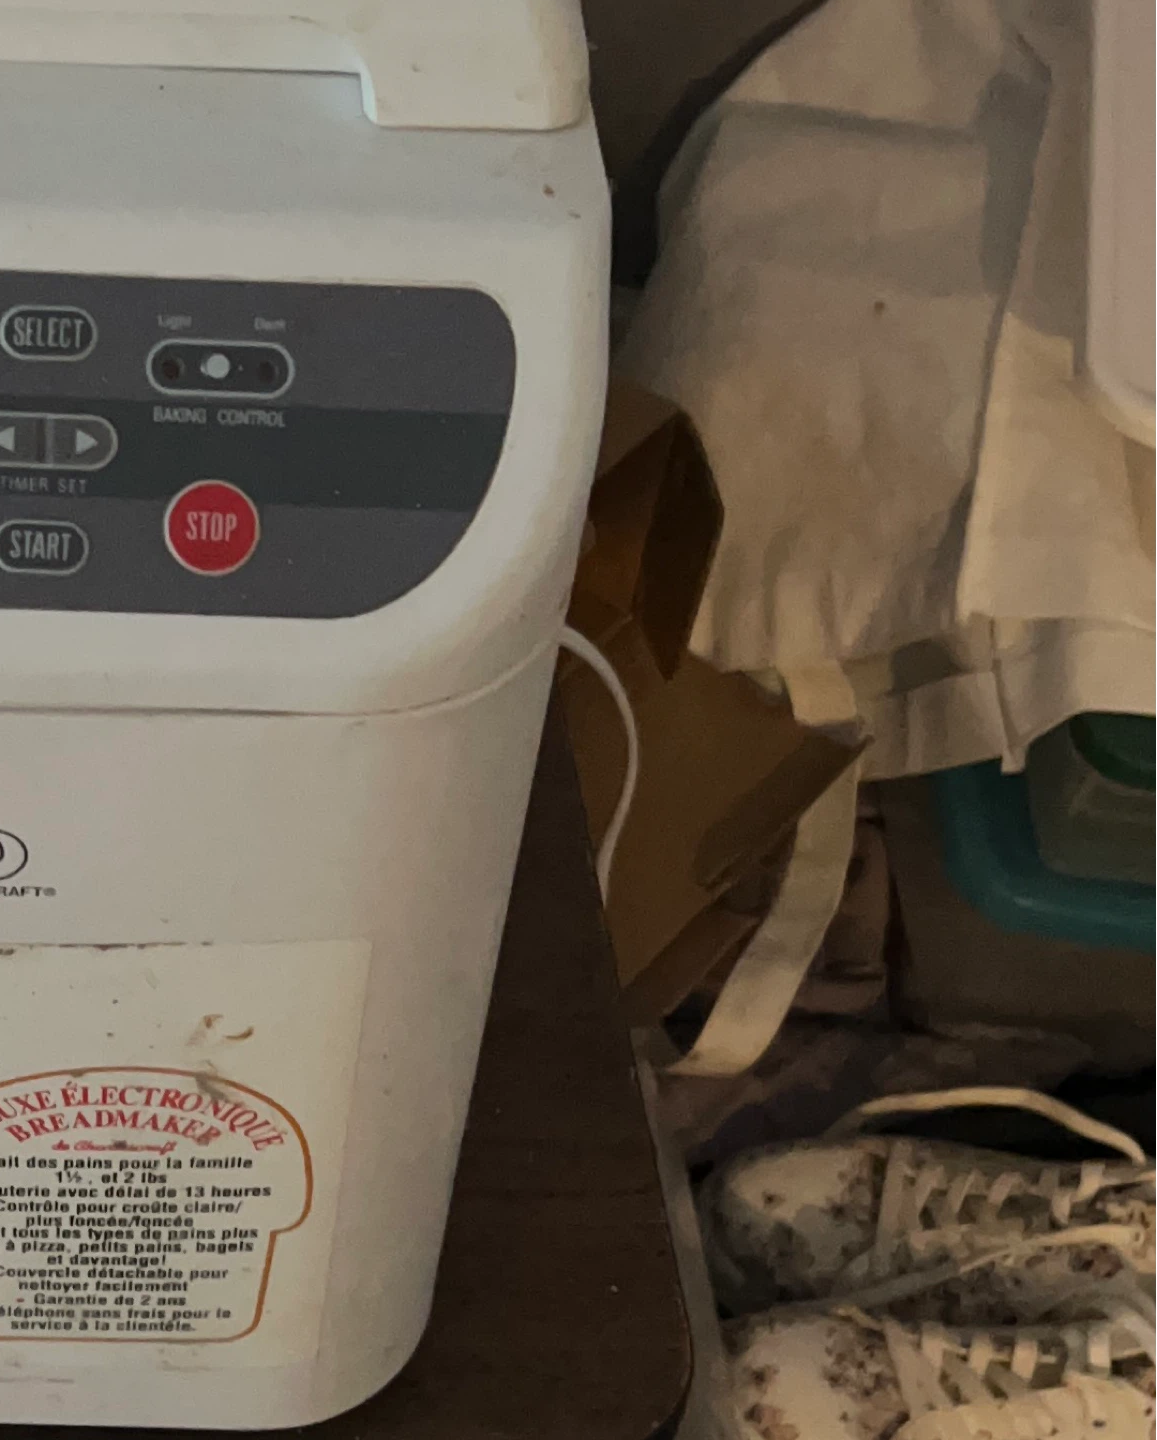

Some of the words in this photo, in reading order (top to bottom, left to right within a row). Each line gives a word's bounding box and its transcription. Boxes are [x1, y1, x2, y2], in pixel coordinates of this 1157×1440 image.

[158, 314, 192, 330] Light
[254, 317, 286, 330] Dark
[13, 317, 85, 349] SELECT
[153, 406, 207, 424] BAKING
[217, 410, 285, 428] CONTROL
[0, 475, 49, 492] TIMER
[58, 478, 87, 494] SET
[185, 512, 238, 542] STOP
[10, 529, 72, 562] START
[4, 1109, 222, 1146] BREADMAKER
[26, 1156, 58, 1169] des
[64, 1157, 113, 1170] pains
[119, 1158, 159, 1171] pour
[167, 1157, 182, 1169] la
[190, 1156, 253, 1169] famille
[101, 1172, 118, 1184] et
[124, 1172, 135, 1184] 2
[141, 1171, 167, 1184] lbs
[57, 1187, 98, 1198] avec
[105, 1185, 149, 1198] délai
[156, 1186, 177, 1198] de
[185, 1185, 205, 1198] 13
[211, 1185, 272, 1197] heures
[76, 1202, 117, 1215] pour
[26, 1215, 62, 1228] plus
[12, 1226, 49, 1238] tous
[56, 1227, 81, 1239] les
[88, 1228, 134, 1241] types
[141, 1228, 162, 1240] de
[168, 1228, 216, 1241] pains
[221, 1227, 259, 1241] plus
[79, 1241, 128, 1254] petits
[196, 1241, 254, 1254] bagels
[47, 1254, 63, 1266] et
[87, 1267, 183, 1279] détachable
[190, 1269, 229, 1282] pour
[19, 1280, 89, 1293] nettoyer
[95, 1280, 188, 1292] facilement
[34, 1292, 107, 1305] Garantie
[114, 1294, 134, 1306] de
[140, 1294, 151, 1306] 2
[157, 1296, 187, 1306] ans
[127, 1307, 166, 1319] frais
[172, 1308, 211, 1321] pour
[216, 1308, 231, 1319] le
[11, 1319, 73, 1330] service
[95, 1320, 110, 1331] la
